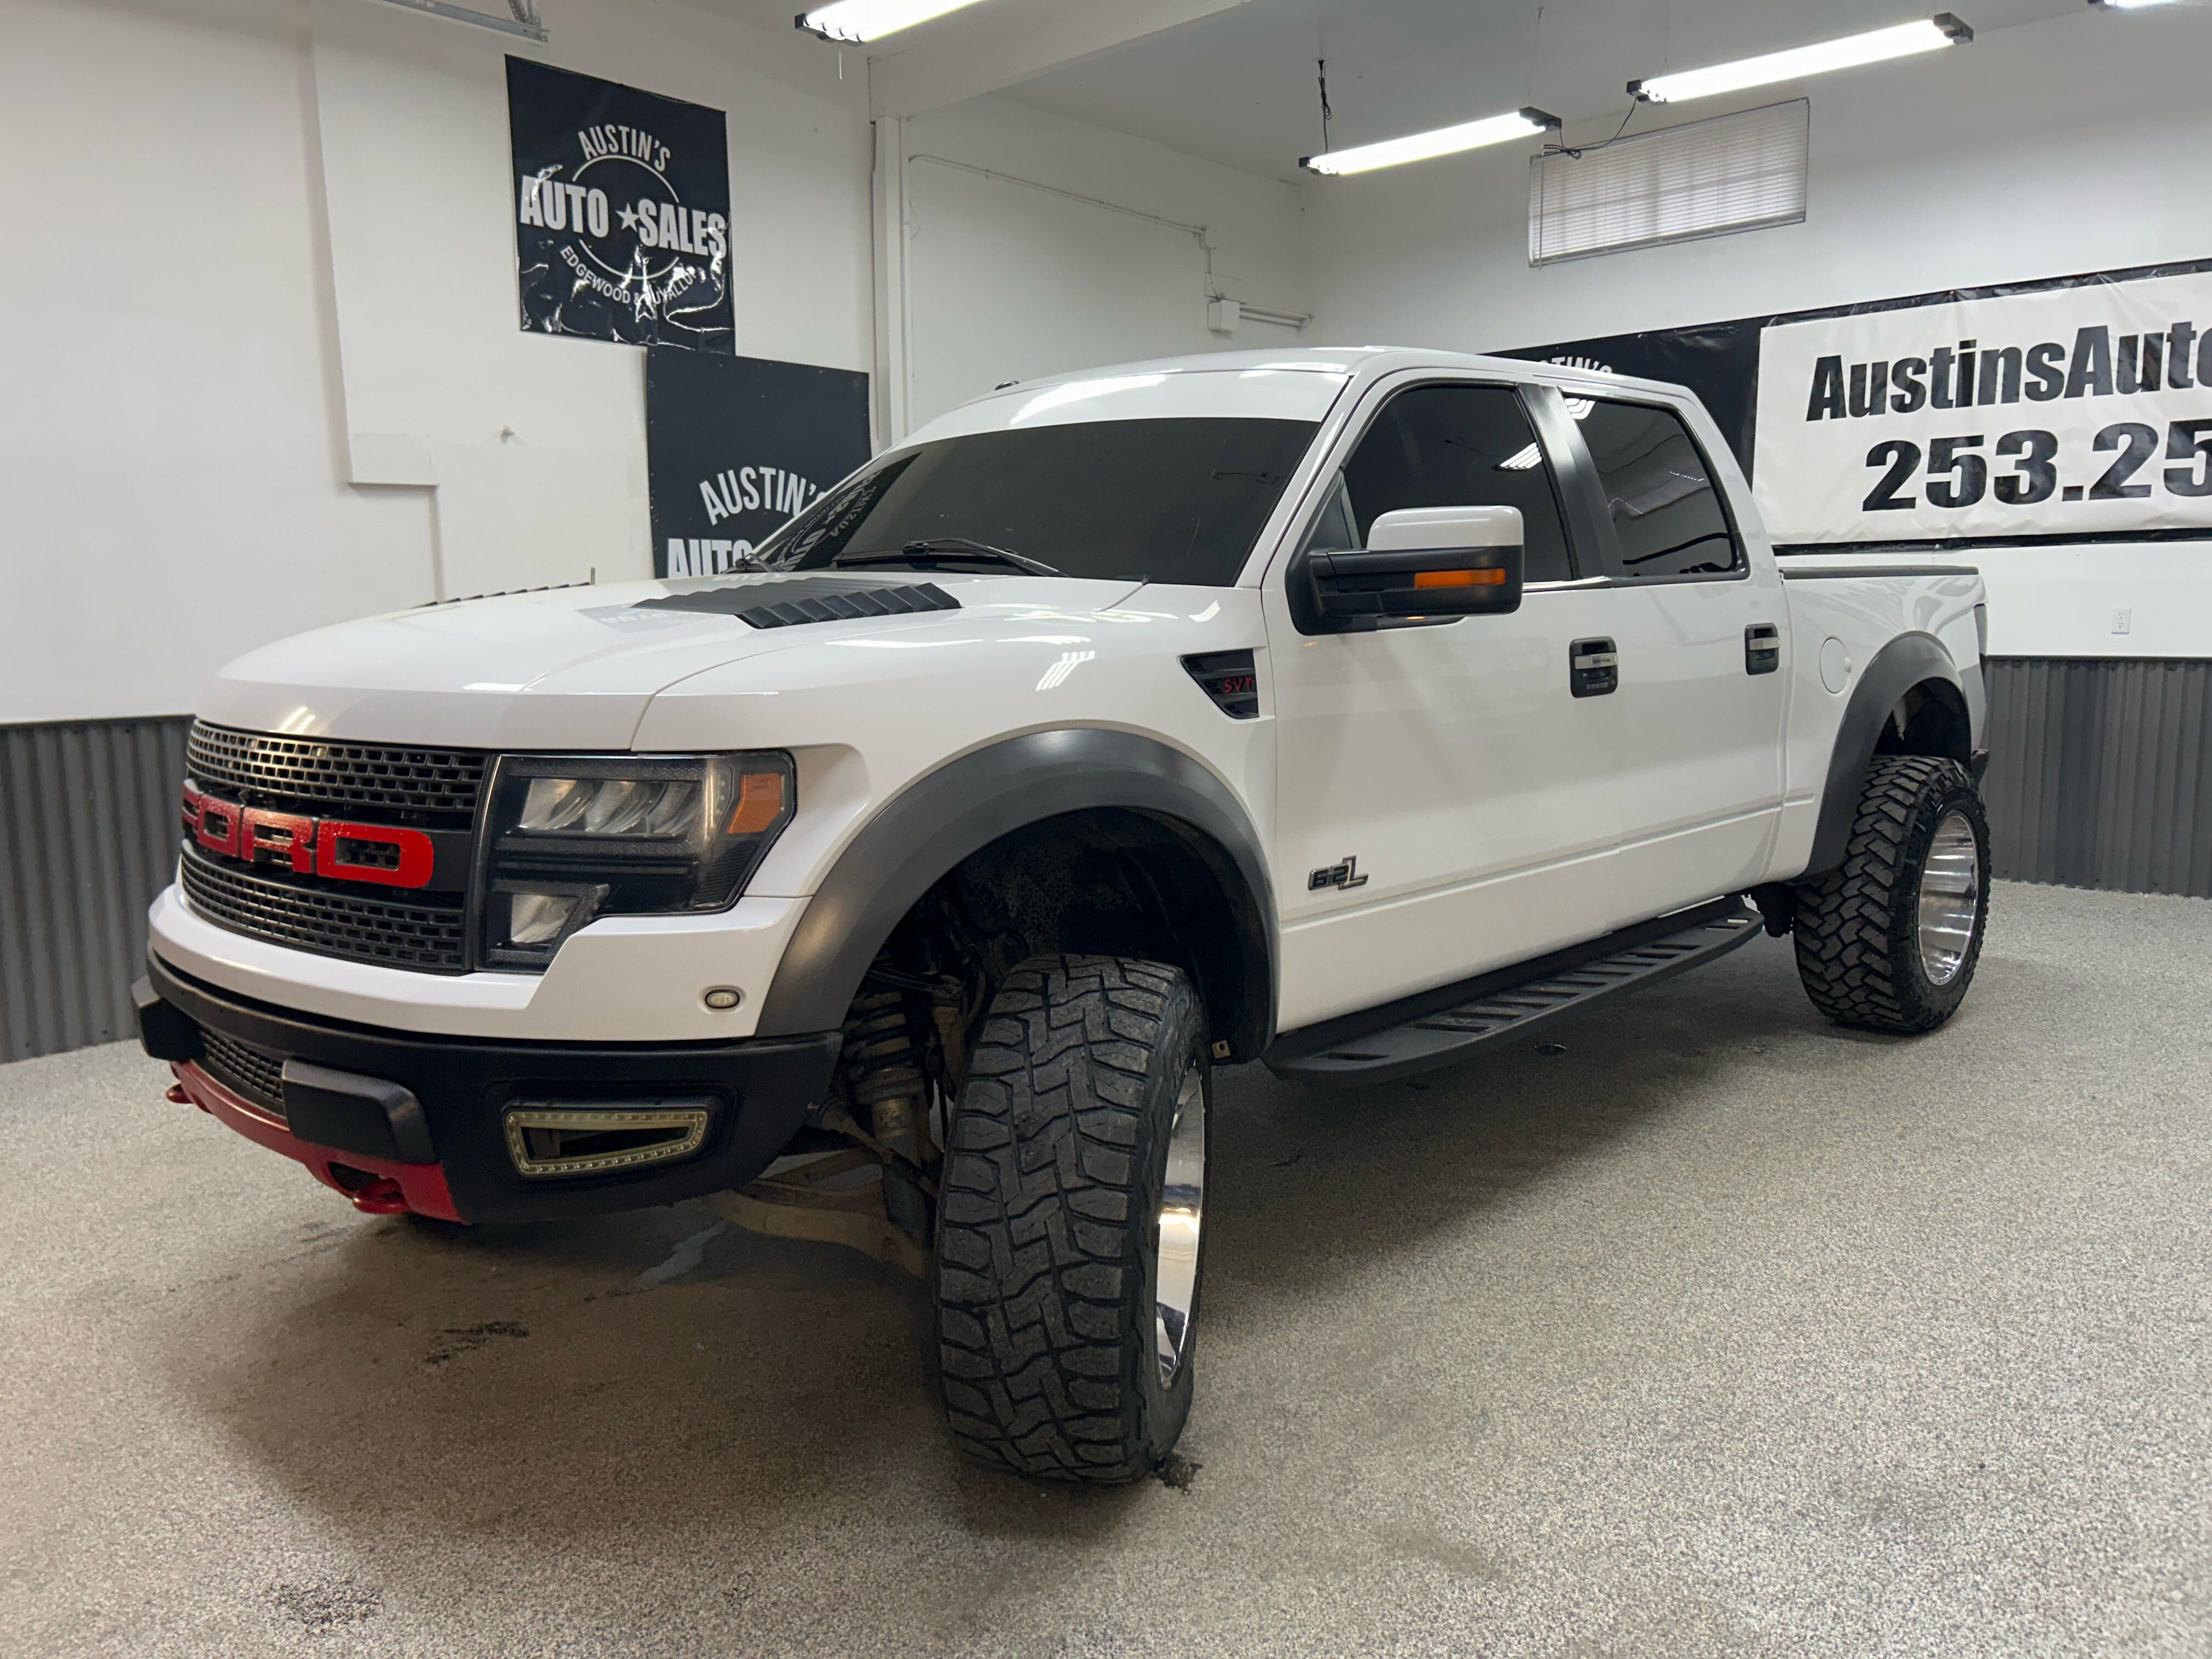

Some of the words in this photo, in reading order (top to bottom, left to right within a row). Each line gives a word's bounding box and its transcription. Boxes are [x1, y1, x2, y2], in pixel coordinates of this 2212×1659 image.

[578, 124, 671, 172] AUSTIN'S
[520, 174, 610, 238] AUTO
[637, 198, 727, 259] SALES
[560, 245, 631, 304] EDGEWOOD
[1862, 419, 2212, 512] 253.25
[698, 466, 826, 526] AUSTIN'
[1223, 676, 1254, 693] SVT
